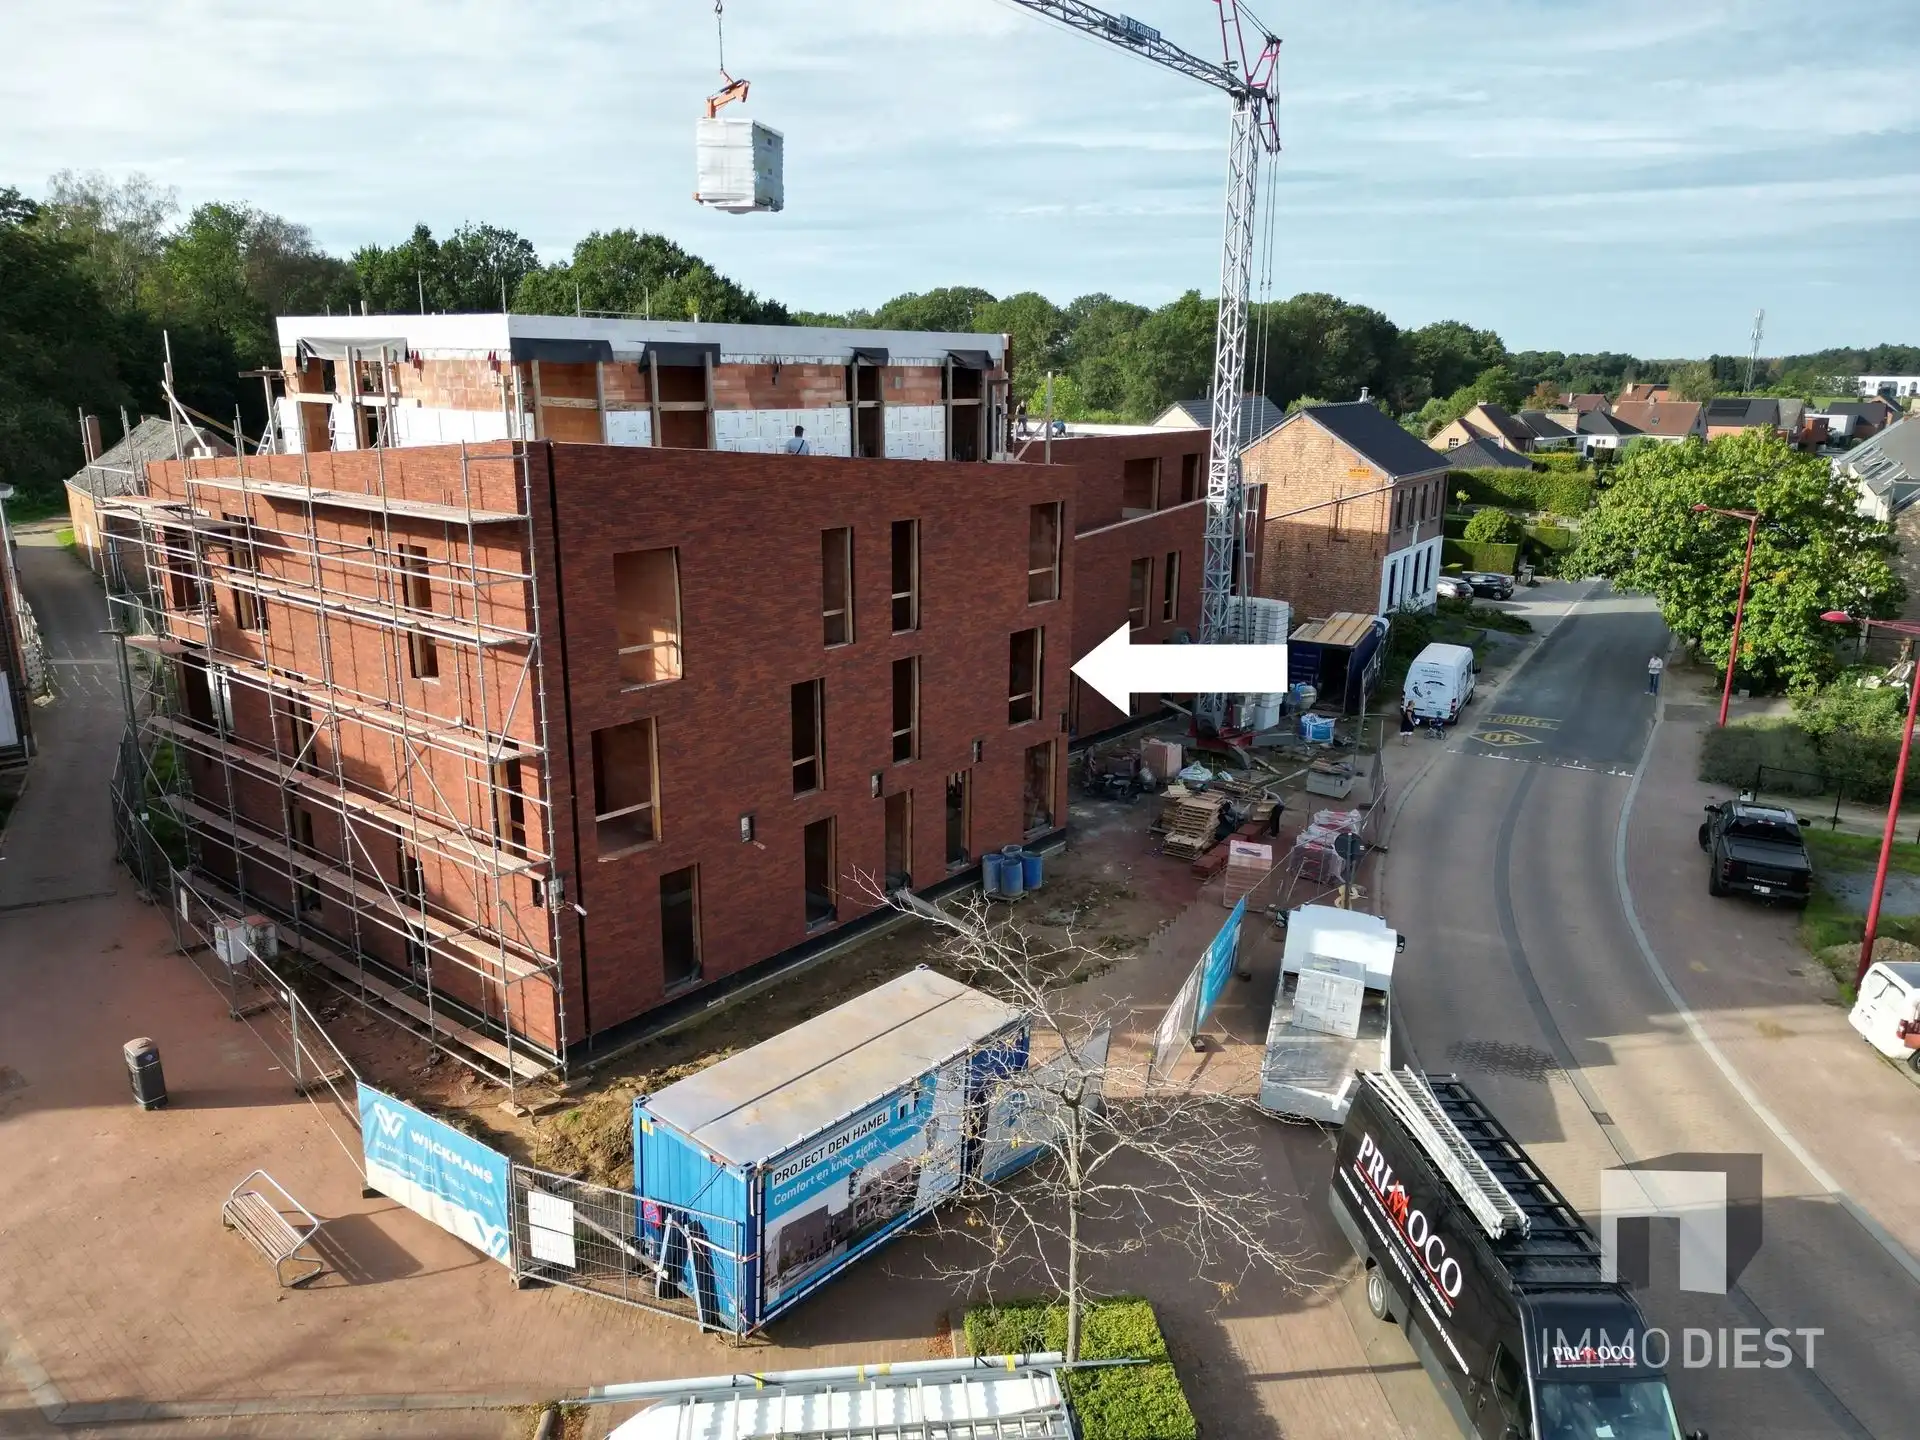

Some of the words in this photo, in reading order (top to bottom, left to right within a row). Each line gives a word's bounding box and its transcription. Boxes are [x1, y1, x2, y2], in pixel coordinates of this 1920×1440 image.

[1129, 20, 1137, 32] DE
[1483, 732, 1521, 745] 30
[774, 1147, 825, 1186] PROJECT
[828, 1131, 851, 1155] DEN
[854, 1112, 889, 1141] HAMEL
[773, 1176, 815, 1206] Comfort
[816, 1166, 829, 1181] en
[831, 1152, 854, 1174] knap
[855, 1139, 879, 1165] zicht
[1356, 1131, 1463, 1298] PRIMOCO
[1552, 1345, 1635, 1361] PRIMOCO
